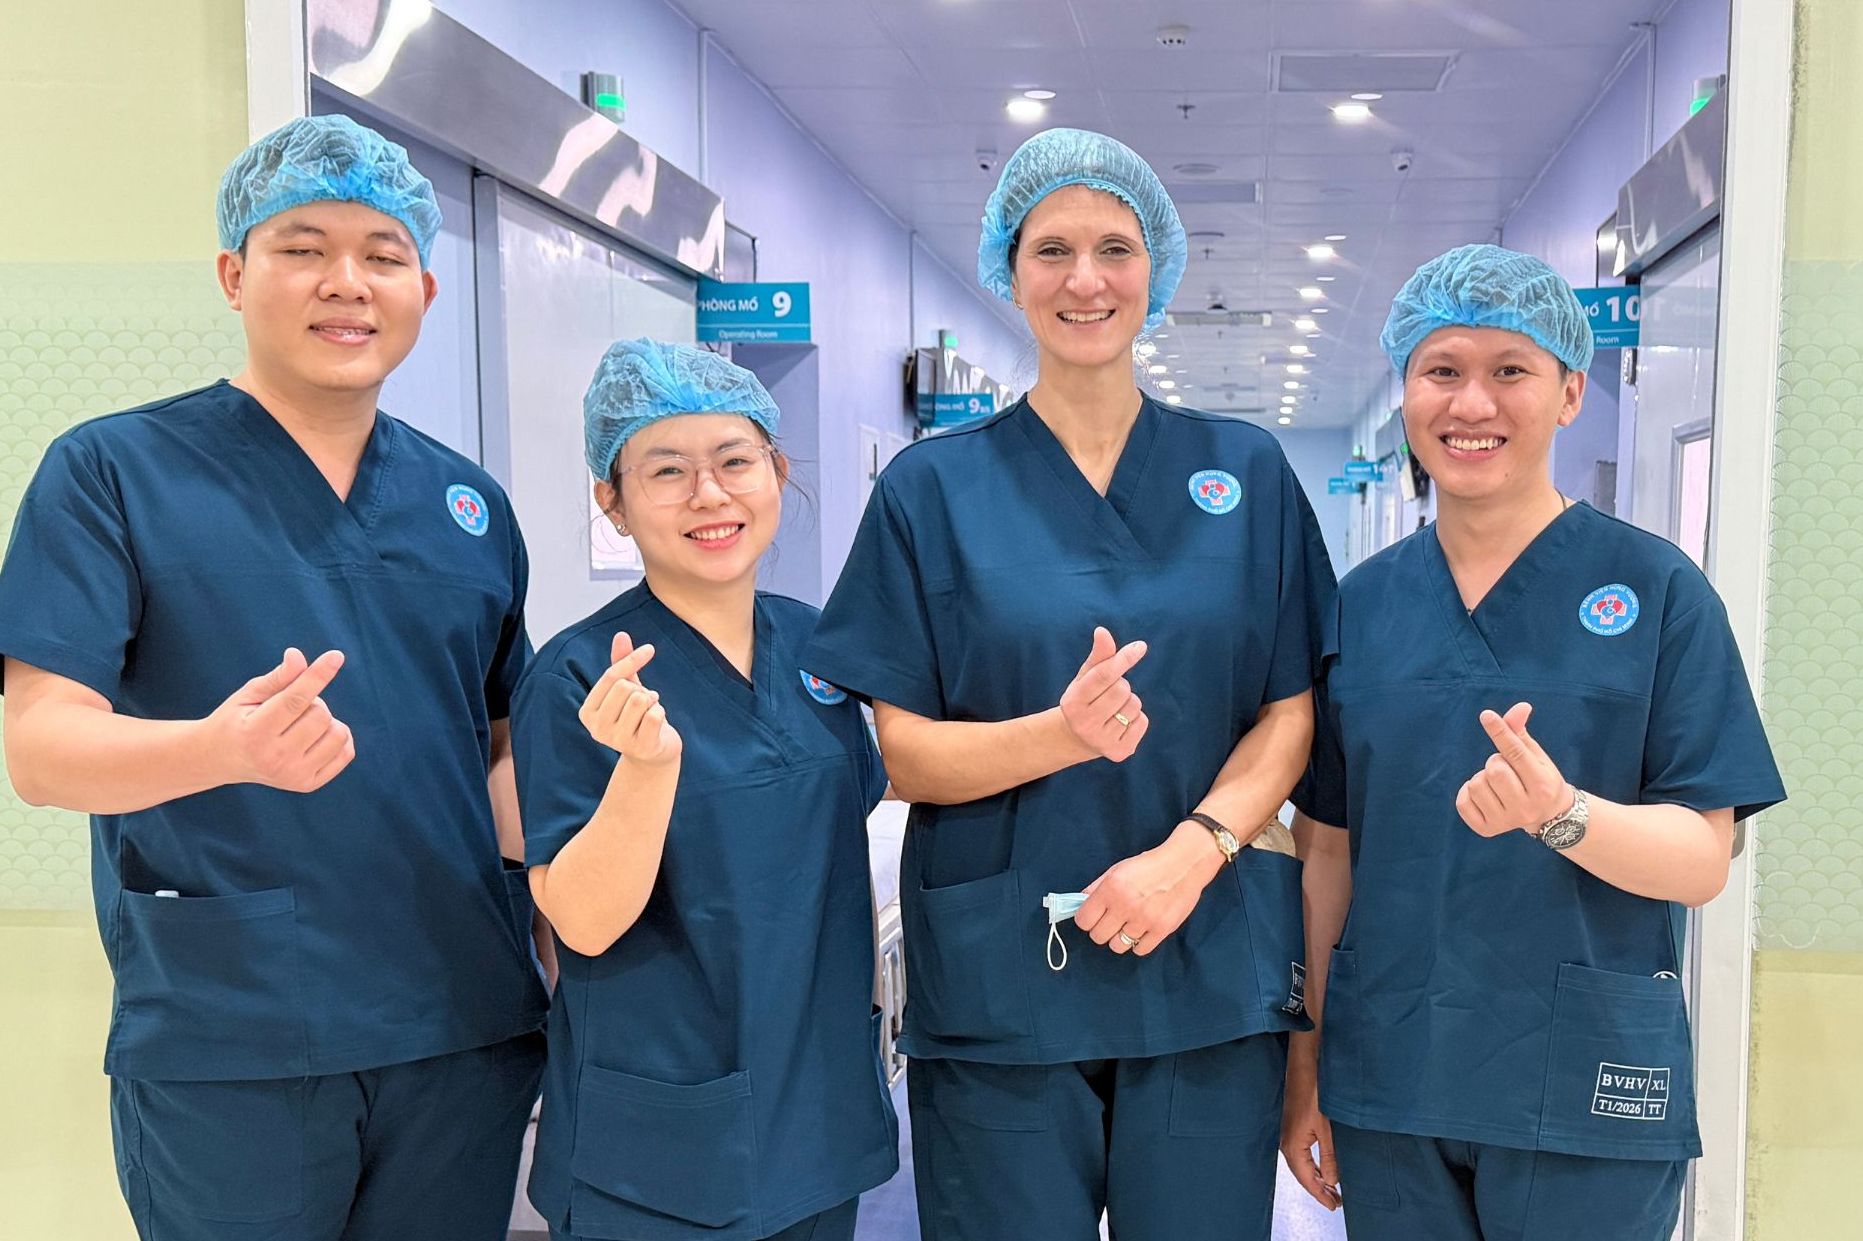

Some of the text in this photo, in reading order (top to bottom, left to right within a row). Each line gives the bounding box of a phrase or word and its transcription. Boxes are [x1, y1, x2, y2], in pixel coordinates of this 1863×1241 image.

[772, 291, 792, 318] 9
[1606, 295, 1640, 322] 10
[718, 329, 778, 340] Operating Room
[1596, 335, 1620, 345] Room
[968, 397, 981, 414] 9
[1601, 1073, 1666, 1091] BVHV XL
[1598, 1099, 1662, 1115] T1/2026 TT
